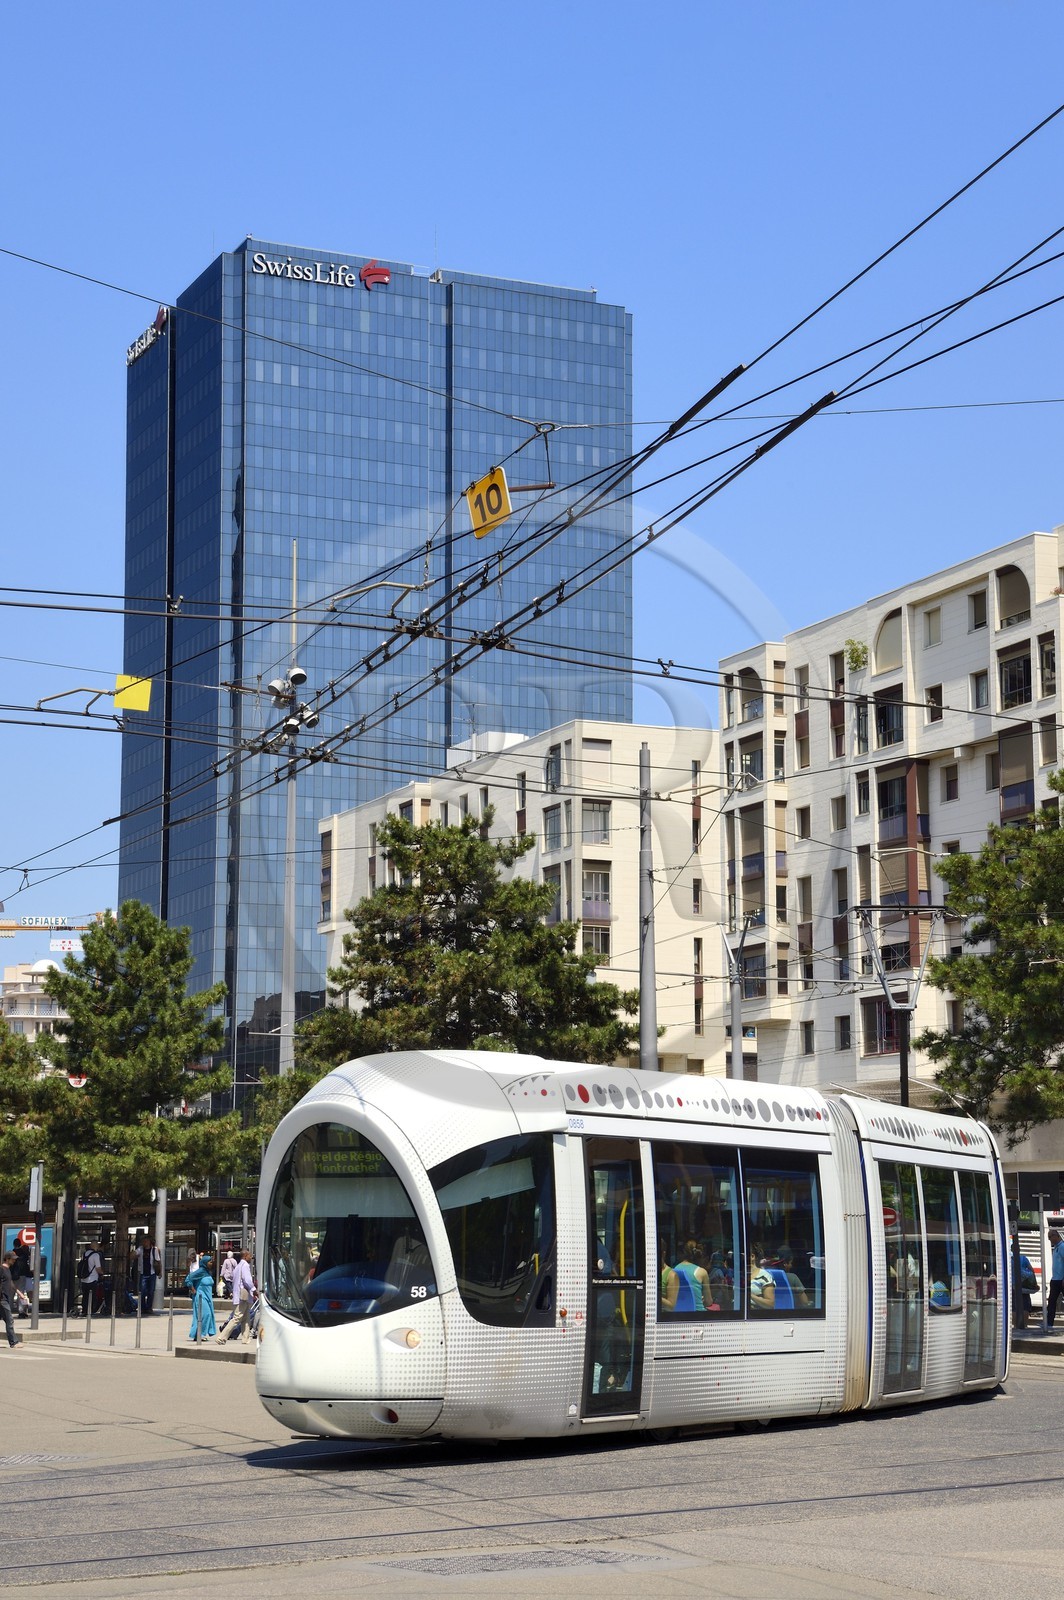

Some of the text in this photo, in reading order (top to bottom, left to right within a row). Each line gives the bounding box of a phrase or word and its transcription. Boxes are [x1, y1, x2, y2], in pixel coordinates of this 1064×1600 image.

[252, 253, 356, 287] SwissLife
[474, 483, 502, 523] 10
[21, 917, 67, 925] SOFIALEX
[334, 1150, 349, 1162] de
[314, 1163, 381, 1174] Montrochet
[410, 1286, 427, 1298] 58
